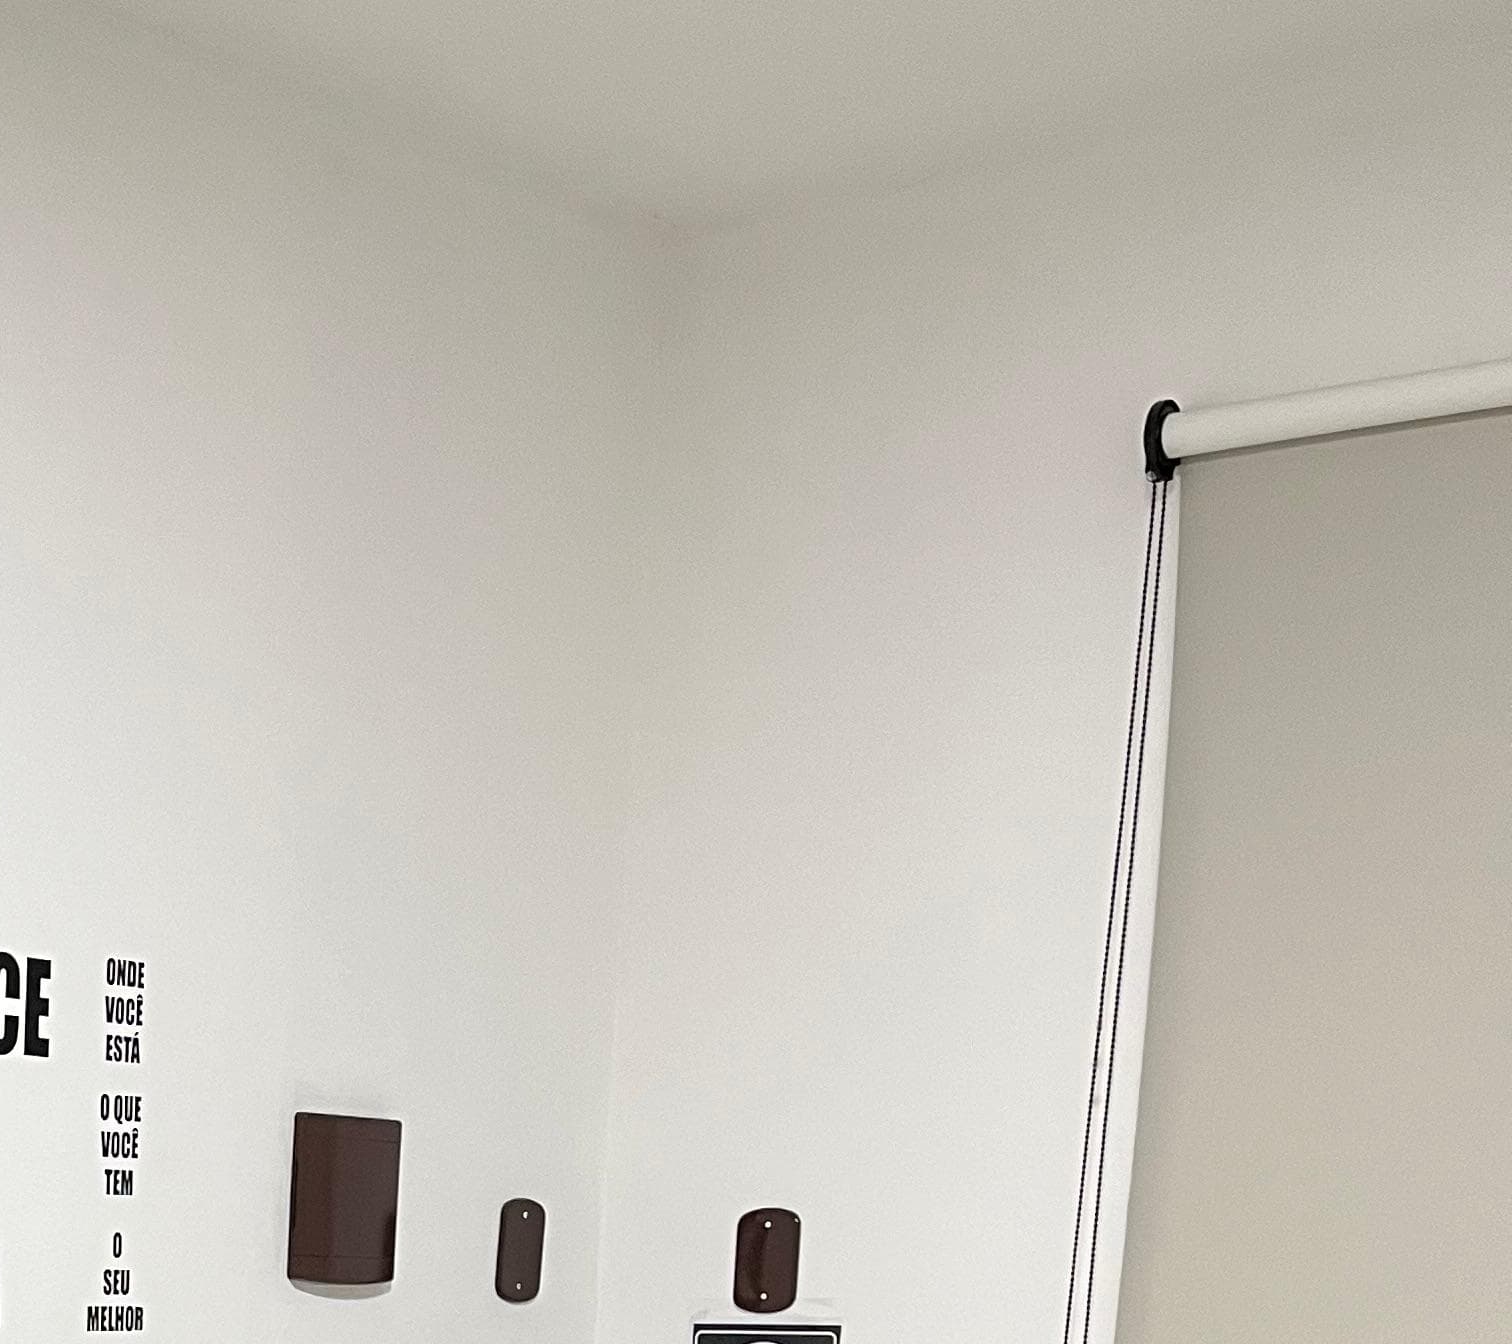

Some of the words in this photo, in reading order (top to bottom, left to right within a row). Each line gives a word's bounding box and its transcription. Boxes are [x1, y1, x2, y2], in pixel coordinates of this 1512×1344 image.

[107, 958, 144, 988] ONDE
[105, 994, 143, 1025] VOCÊ
[106, 1032, 140, 1063] ESTÁ
[101, 1094, 109, 1120] O
[114, 1095, 141, 1124] QUE
[101, 1128, 138, 1158] VOCÊ
[105, 1169, 133, 1195] TEM
[113, 1233, 122, 1258] O
[104, 1270, 129, 1295] SEU
[87, 1306, 143, 1331] MELHOR
